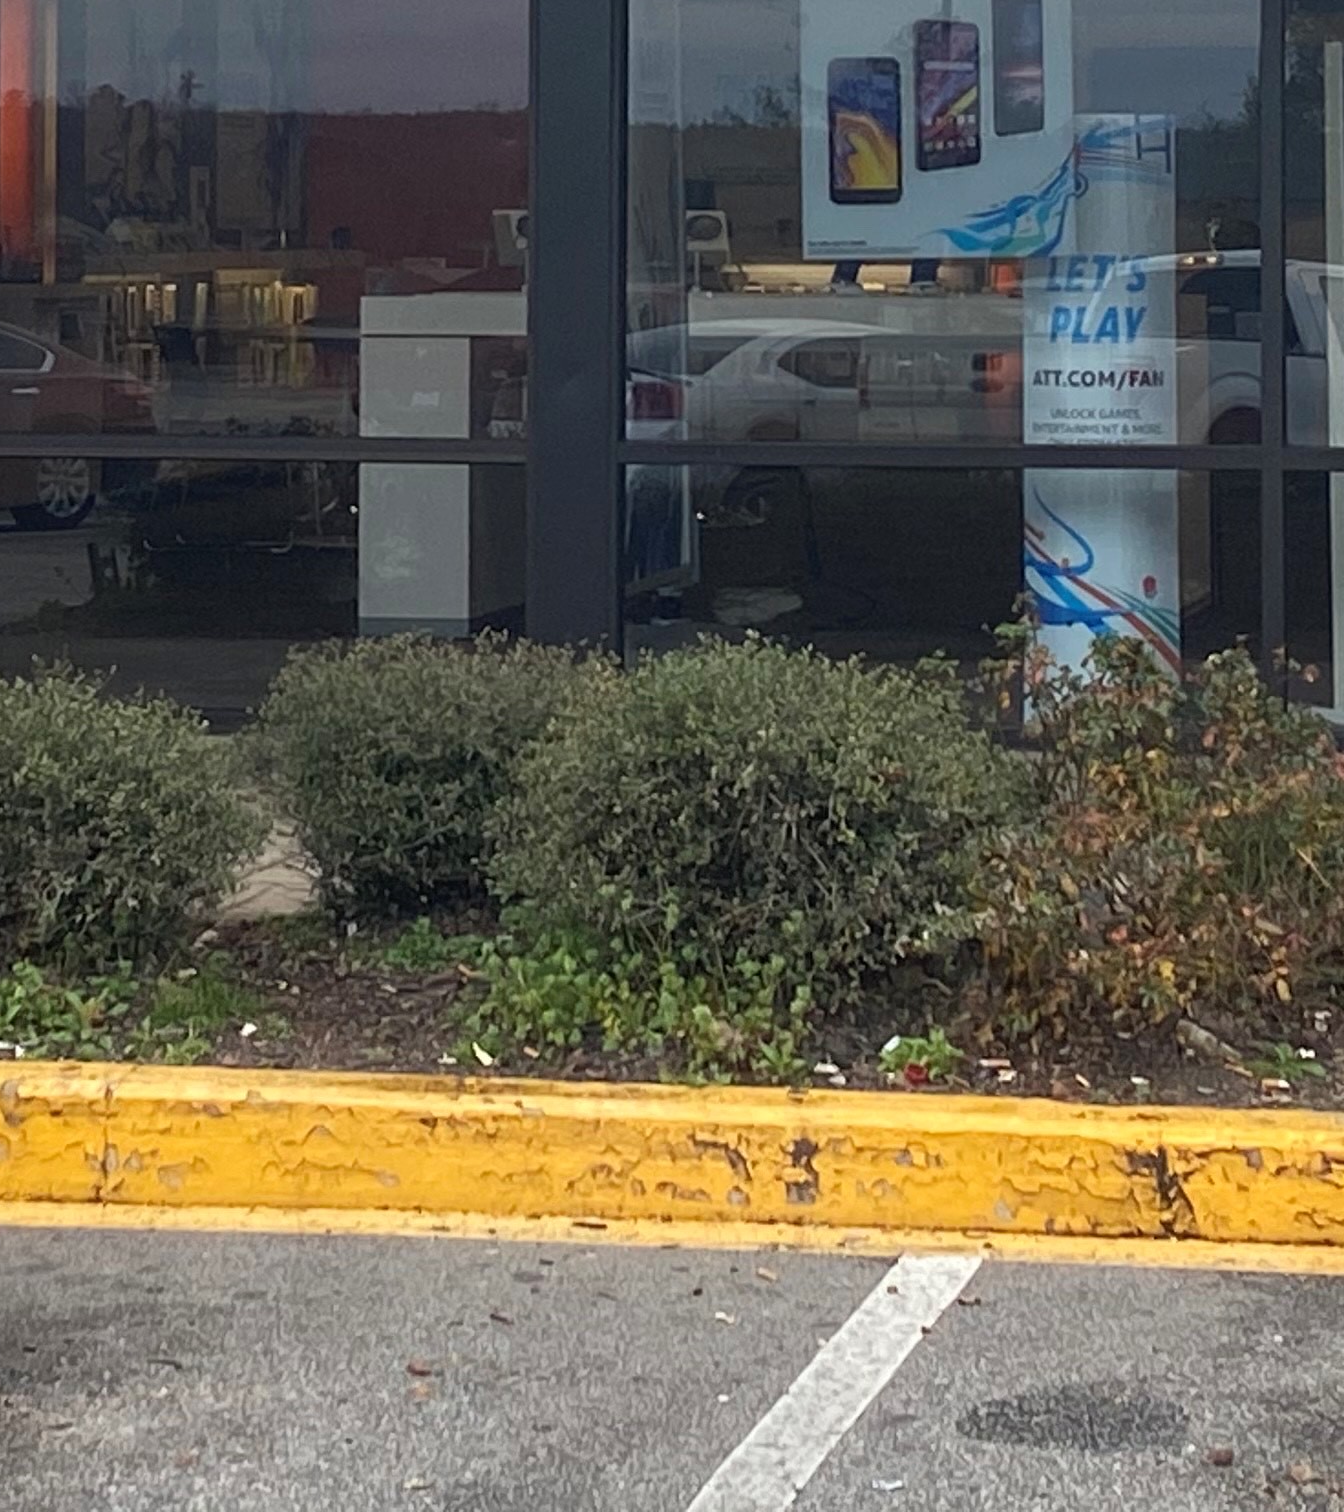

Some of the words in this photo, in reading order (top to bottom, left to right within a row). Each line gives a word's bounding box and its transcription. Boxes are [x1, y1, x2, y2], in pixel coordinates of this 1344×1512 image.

[1046, 254, 1150, 292] LET'S
[1050, 305, 1147, 344] PLAY
[1032, 369, 1165, 391] ATT.COM/FAN
